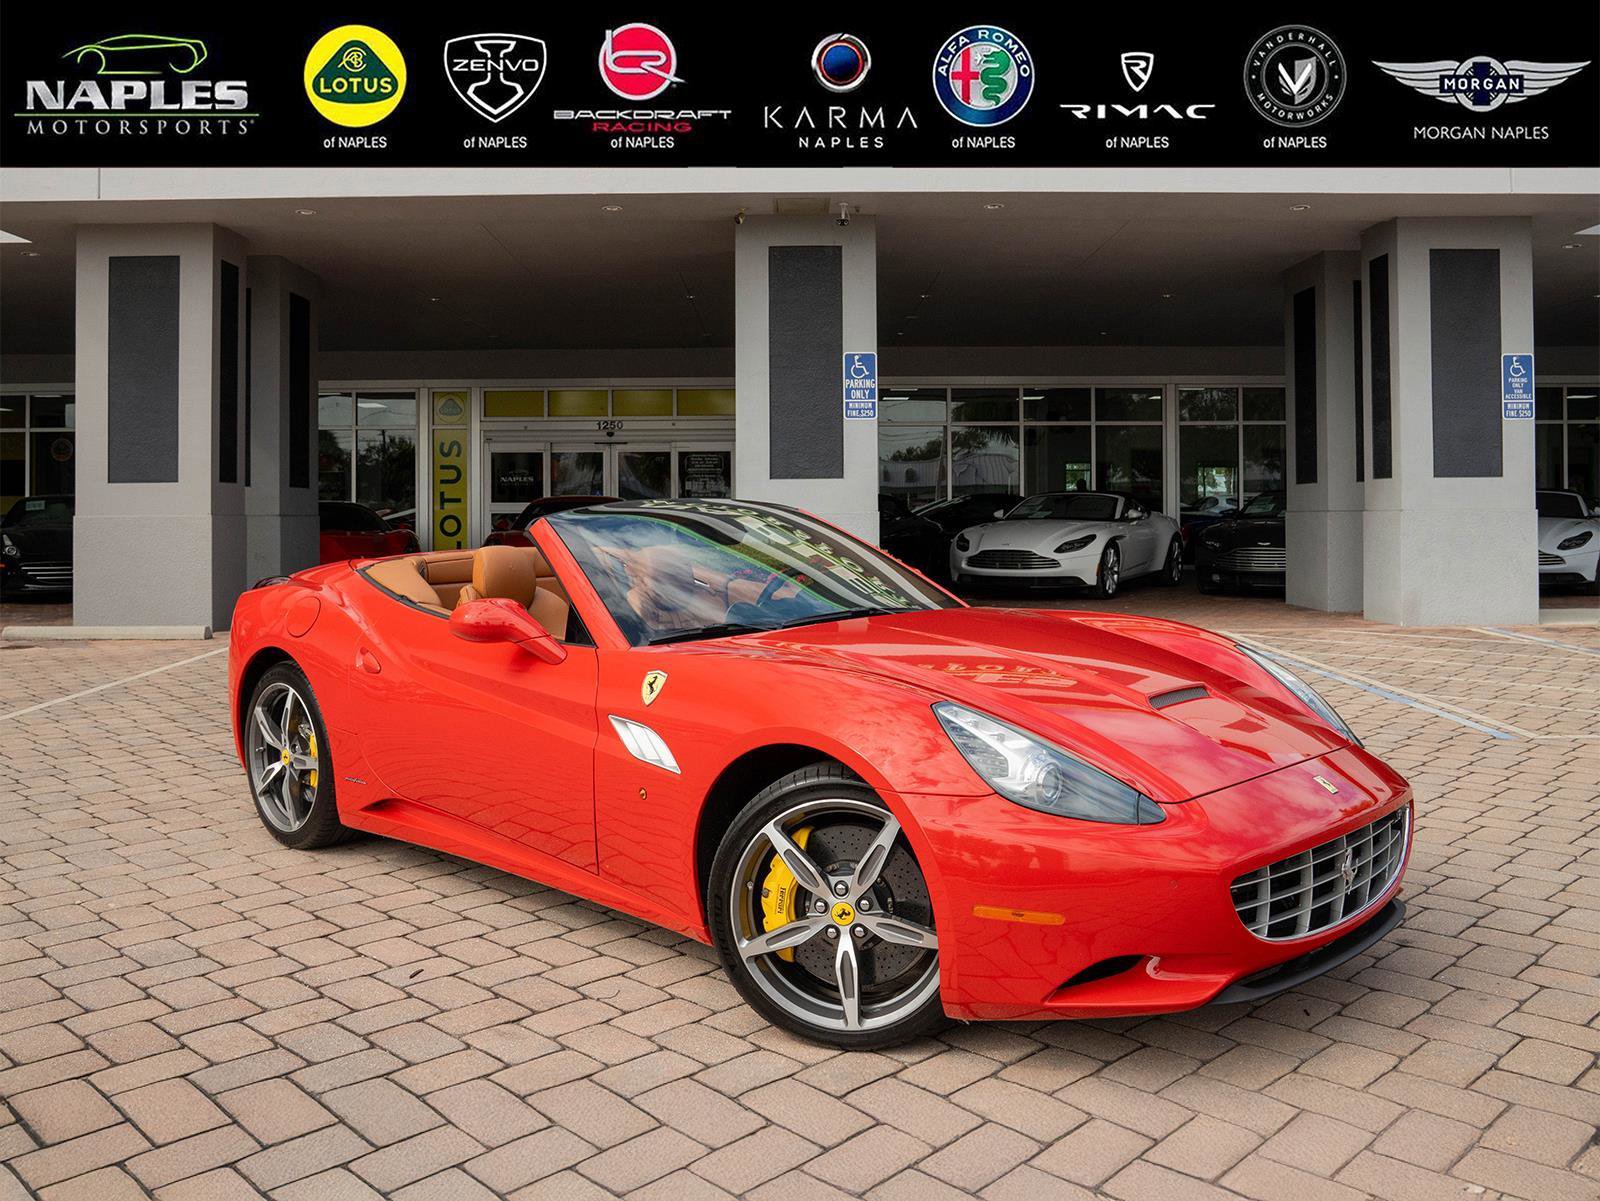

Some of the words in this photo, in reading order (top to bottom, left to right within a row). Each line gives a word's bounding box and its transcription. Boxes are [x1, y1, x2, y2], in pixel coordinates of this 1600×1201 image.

[845, 378, 876, 389] PARKING
[851, 389, 870, 399] ONLY
[596, 420, 624, 430] 1250
